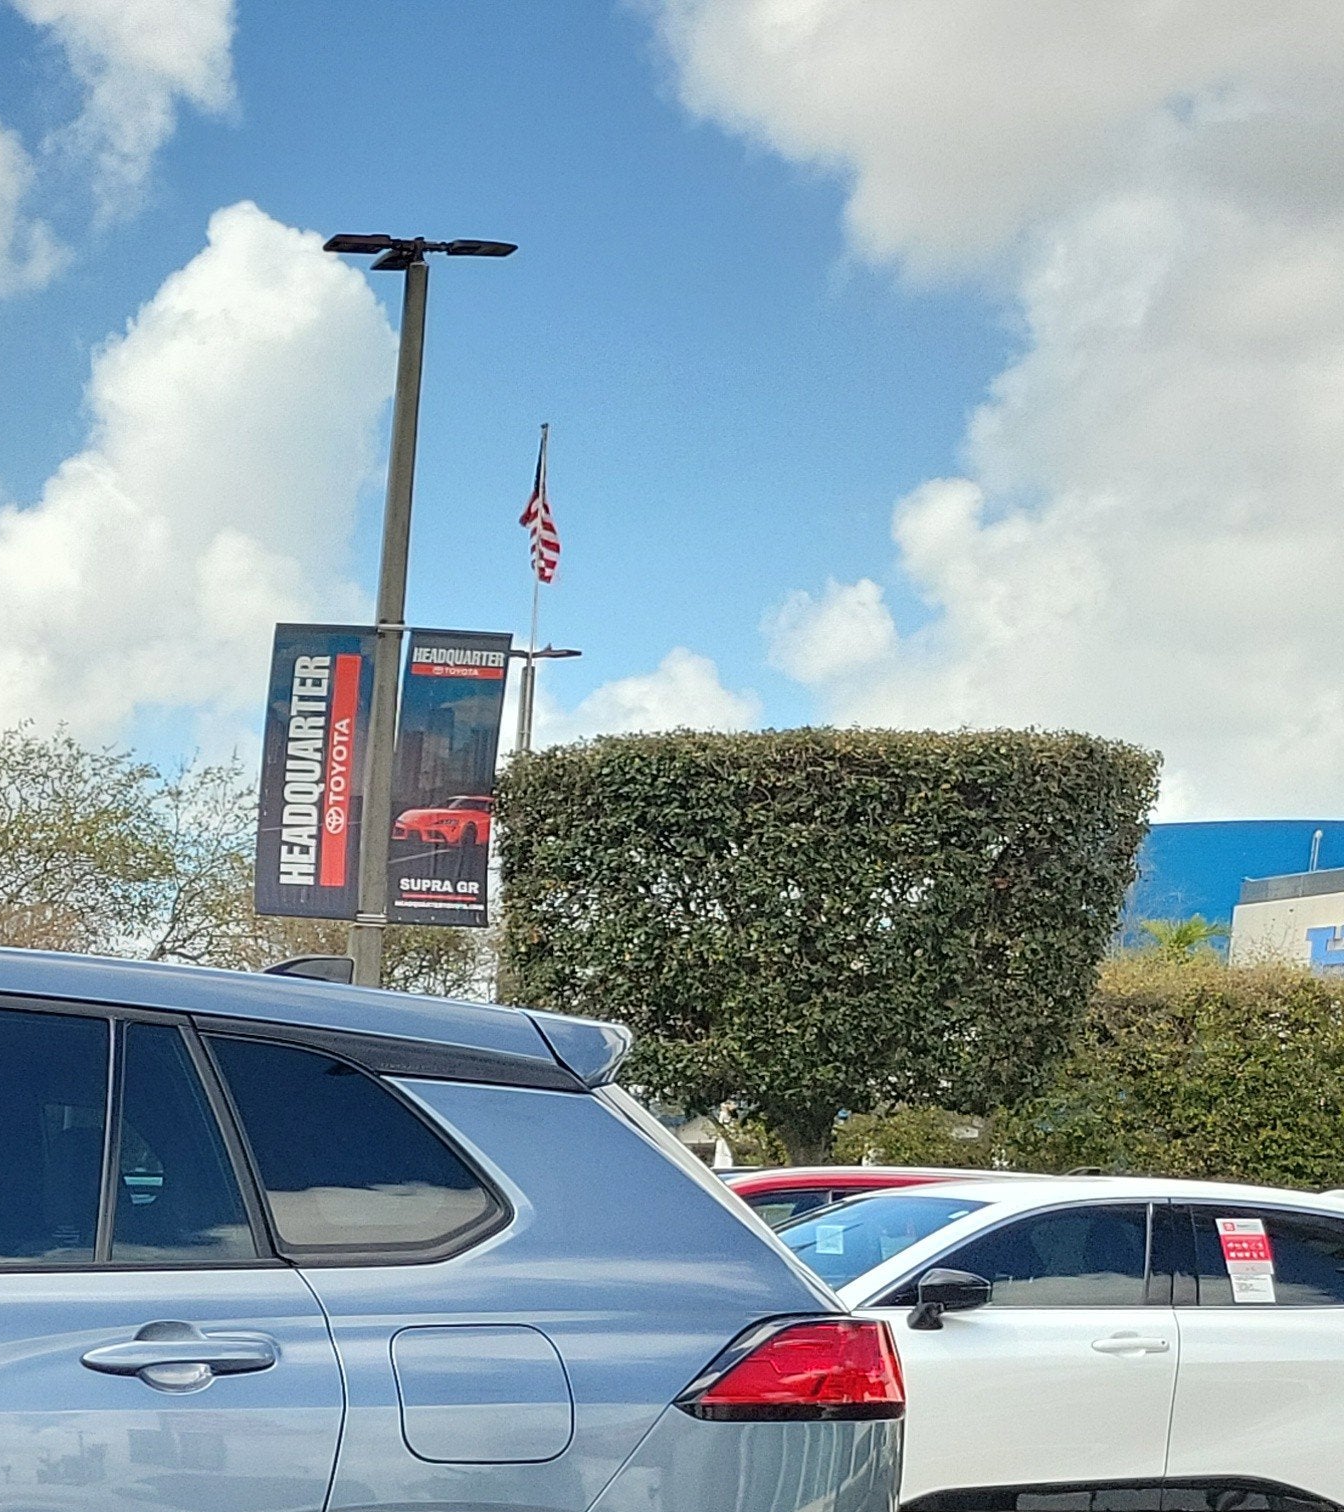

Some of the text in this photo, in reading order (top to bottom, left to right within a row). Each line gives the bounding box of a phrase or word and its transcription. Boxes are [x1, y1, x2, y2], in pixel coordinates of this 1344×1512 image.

[413, 647, 505, 667] HEADQUARTER
[444, 667, 480, 676] TOYOTA
[279, 655, 331, 886] HEADQUARTER
[329, 718, 350, 804] TOYOTA
[399, 878, 479, 893] SUPRA GR
